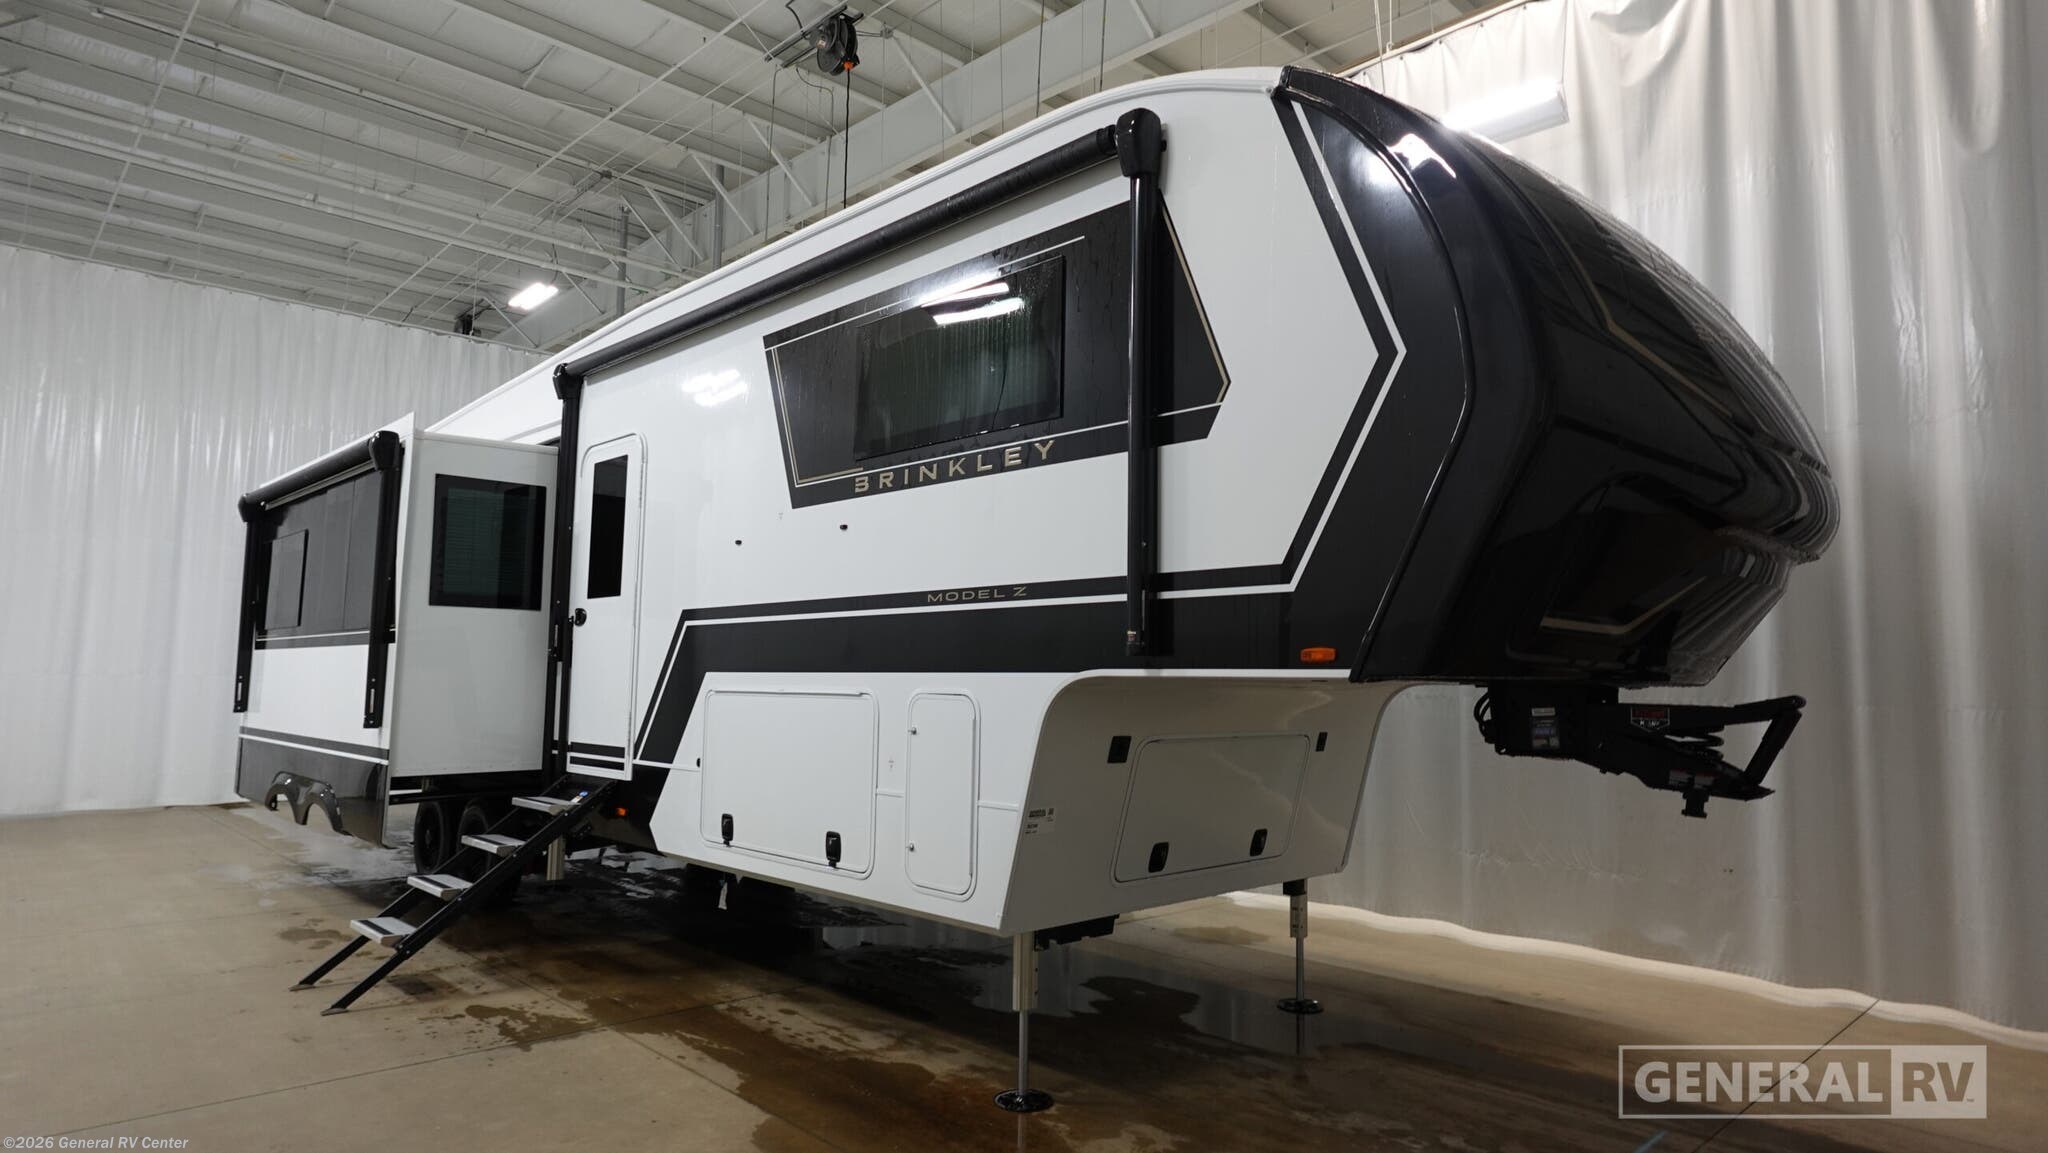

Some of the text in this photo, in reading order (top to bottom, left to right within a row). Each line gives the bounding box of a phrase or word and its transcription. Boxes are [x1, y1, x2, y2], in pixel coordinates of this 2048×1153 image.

[854, 439, 1056, 493] BRINKLEY
[927, 586, 1028, 603] MODEL Z
